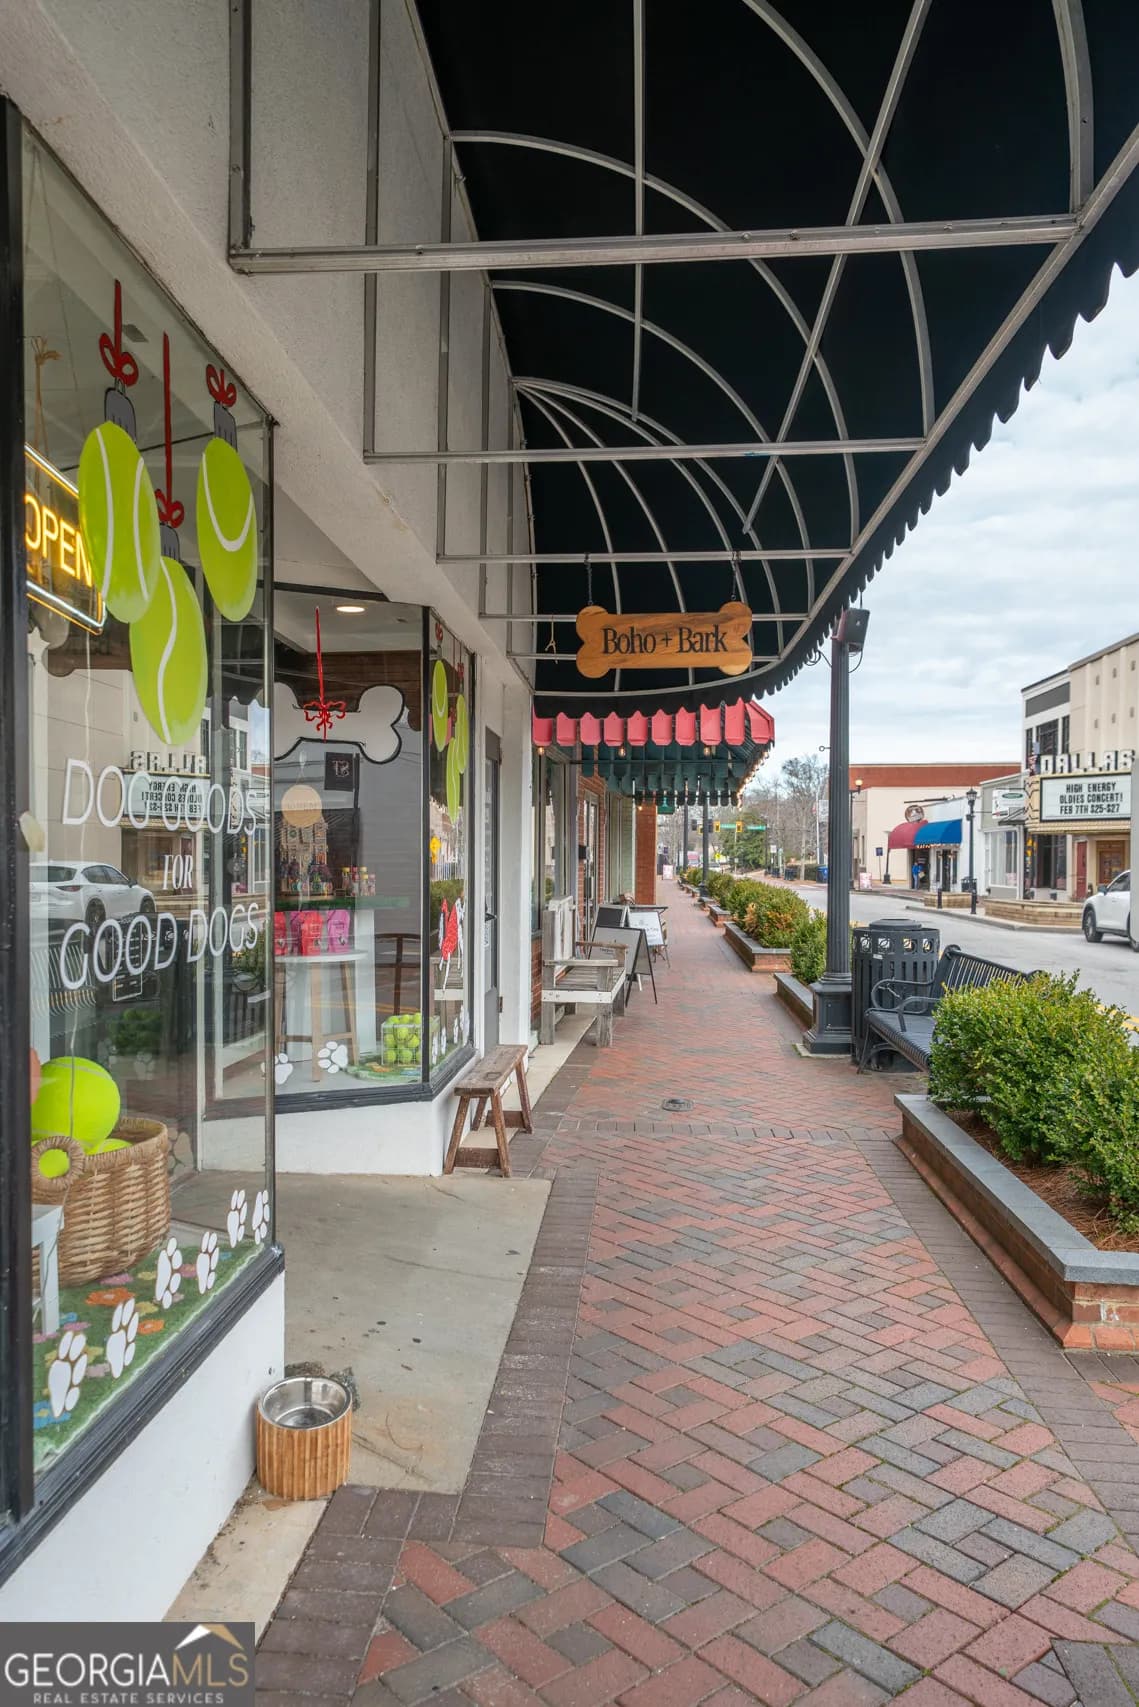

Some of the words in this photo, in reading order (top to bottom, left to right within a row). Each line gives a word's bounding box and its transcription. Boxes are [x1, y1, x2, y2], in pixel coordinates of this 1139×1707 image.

[25, 493, 93, 588] OPEN
[602, 625, 656, 655] Boho
[661, 631, 673, 648] +
[676, 624, 729, 654] Bark
[1040, 750, 1135, 774] DALLAS
[62, 757, 151, 830] DOG
[161, 775, 257, 836] GOODS
[1059, 794, 1085, 805] OLDIES
[1087, 792, 1123, 803] CONCERT!
[1066, 783, 1083, 793] HIGH
[1087, 782, 1117, 793] ENERGY
[1060, 805, 1073, 815] FEB
[1075, 804, 1089, 814] 7TH
[1090, 803, 1121, 814] $25-$27
[162, 854, 194, 890] FOR
[60, 912, 178, 990] GOOD
[187, 902, 259, 963] DOGS
